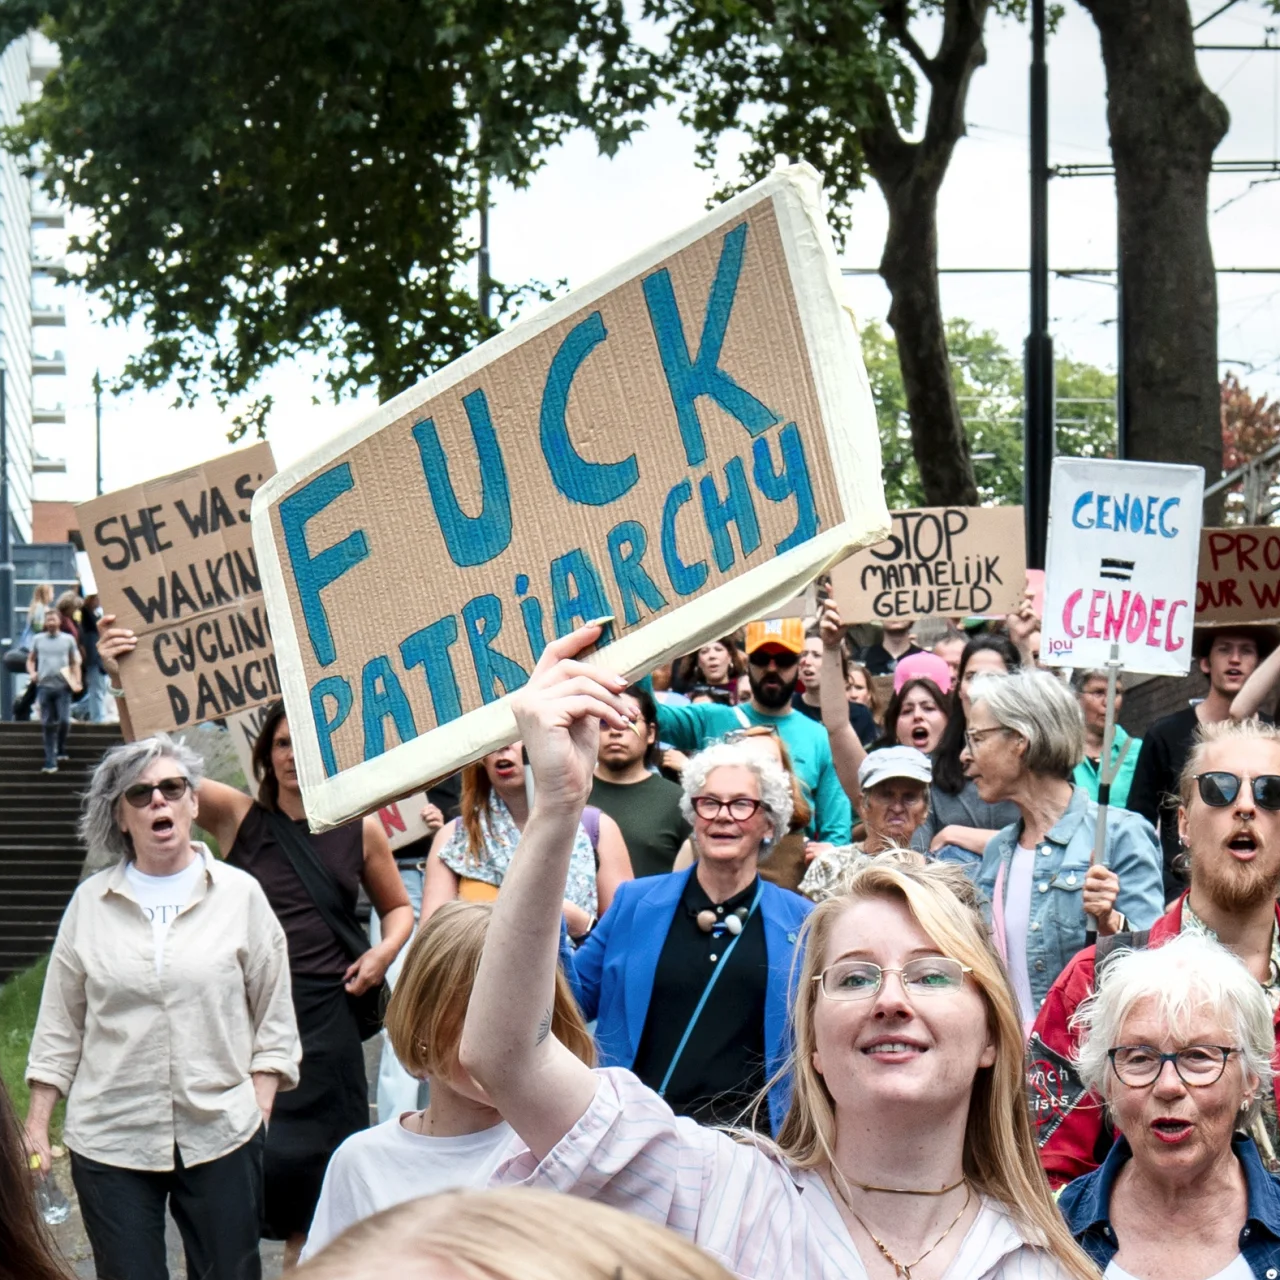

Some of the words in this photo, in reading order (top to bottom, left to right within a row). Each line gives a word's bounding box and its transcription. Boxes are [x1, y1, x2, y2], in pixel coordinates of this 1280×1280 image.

[278, 221, 778, 667] FUCK
[94, 504, 174, 572] SHE
[869, 509, 969, 562] STOP
[1072, 490, 1181, 539] GENOEG
[122, 546, 262, 625] WALKIN
[873, 586, 993, 618] GEWELD
[1196, 578, 1244, 613] OUR
[152, 606, 272, 678] CYCLIN
[1062, 588, 1188, 652] GENOEG
